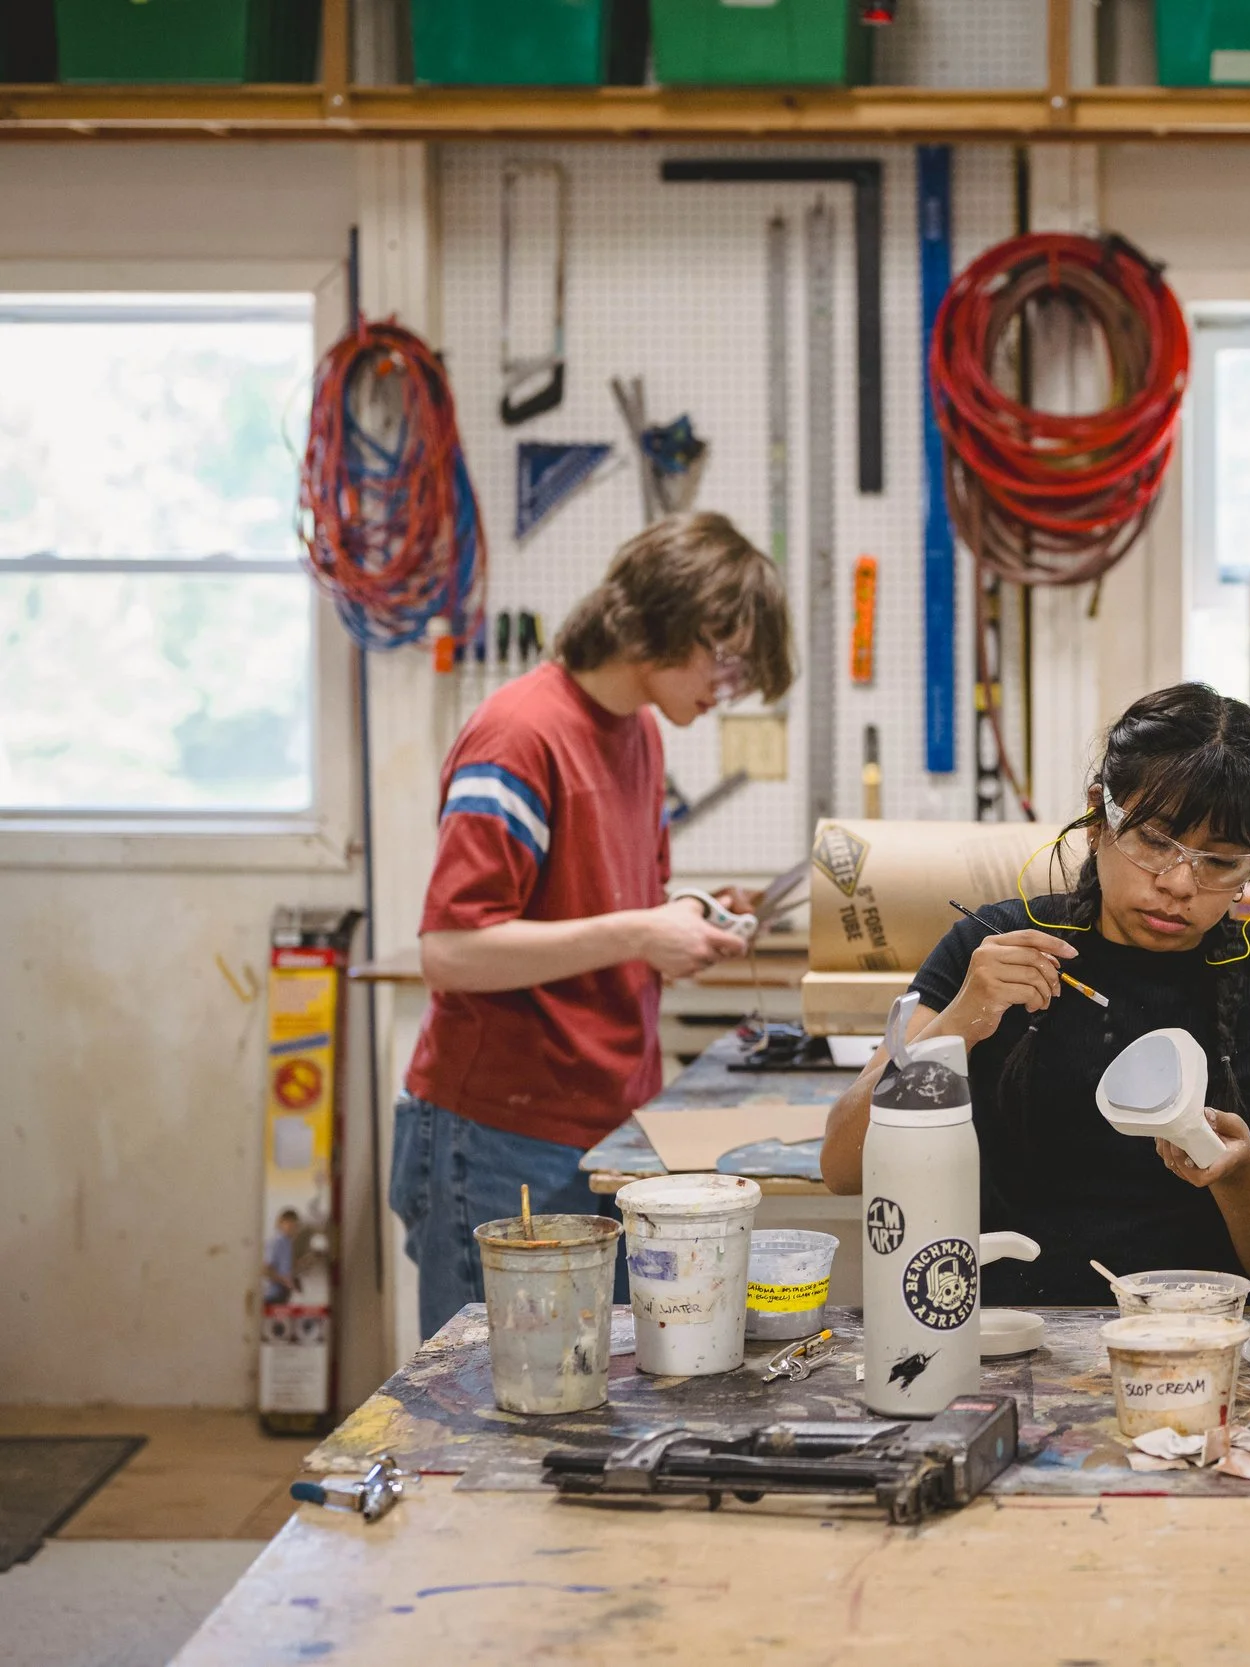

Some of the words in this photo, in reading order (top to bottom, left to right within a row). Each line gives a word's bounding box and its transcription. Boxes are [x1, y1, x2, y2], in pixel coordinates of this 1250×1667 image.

[838, 903, 863, 943] TUBE
[861, 905, 888, 948] FORM
[871, 1227, 903, 1254] ART
[905, 1240, 975, 1293] BENCHMARK
[659, 1302, 702, 1315] WATER
[914, 1275, 977, 1328] ABRASIVES
[1125, 1383, 1153, 1397] SLOP
[1156, 1379, 1206, 1396] CREAM
